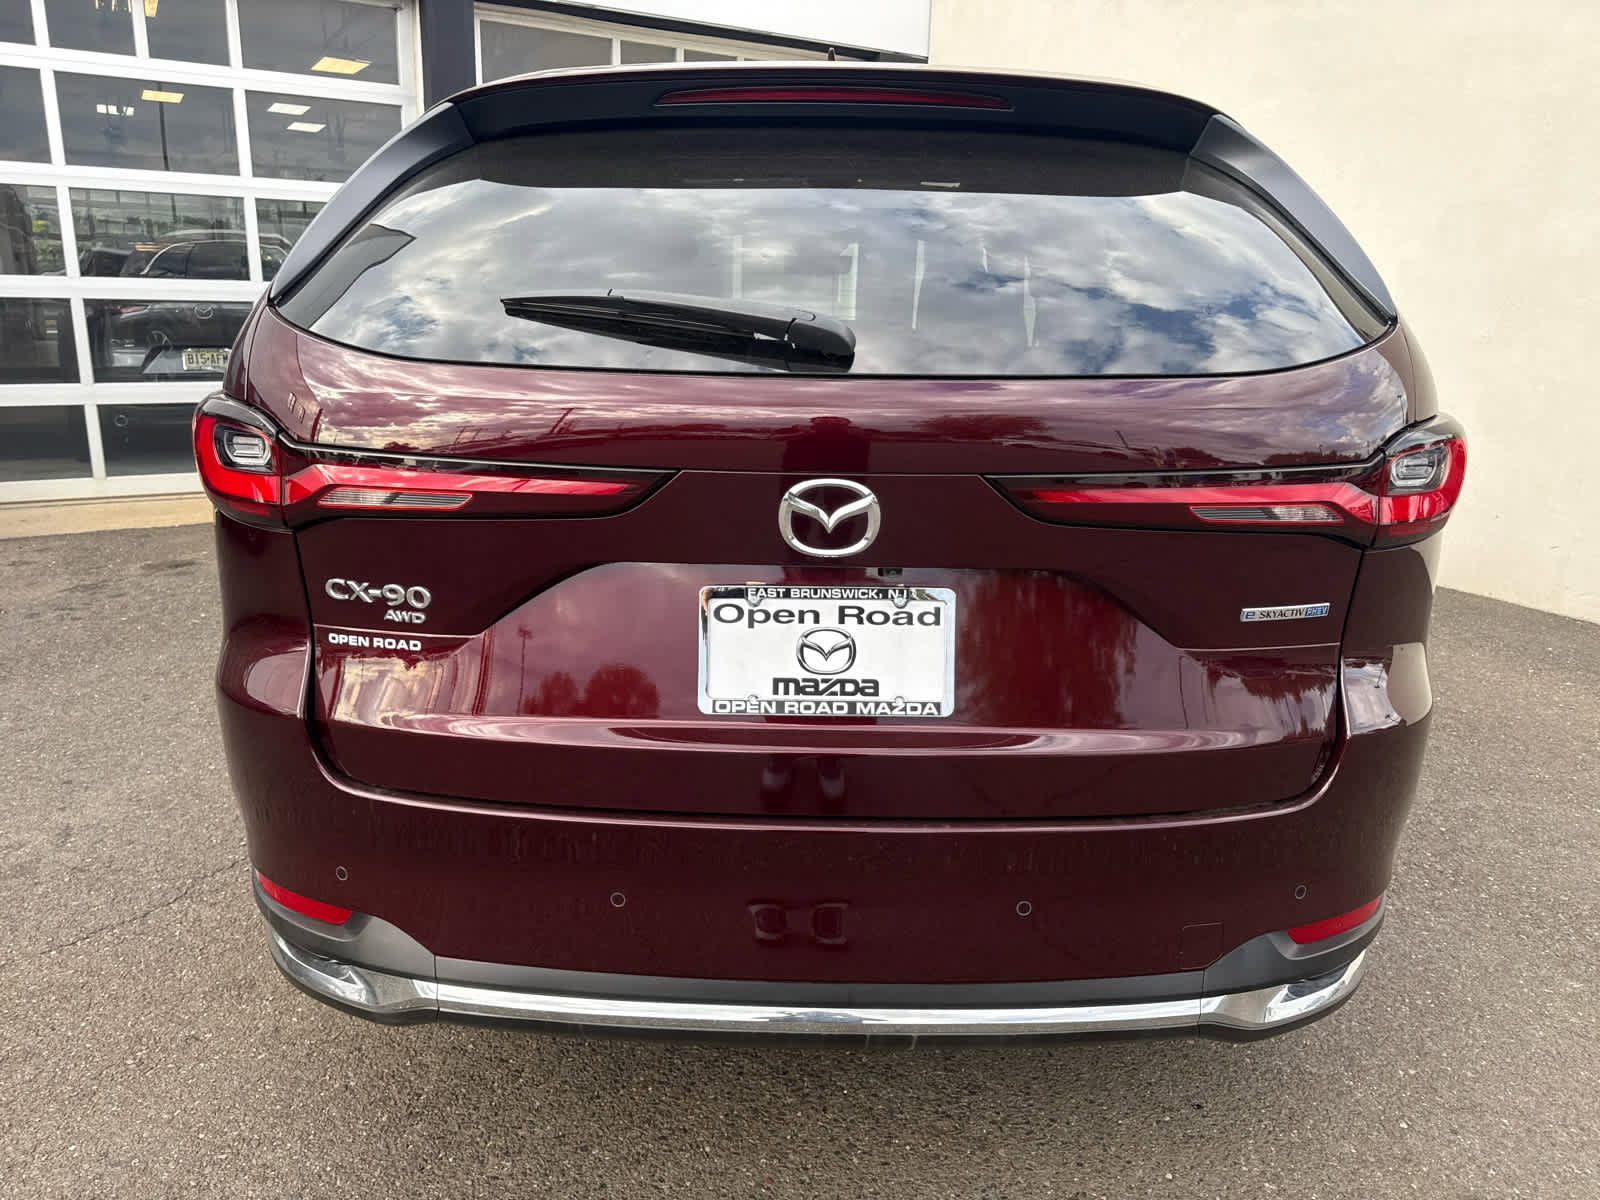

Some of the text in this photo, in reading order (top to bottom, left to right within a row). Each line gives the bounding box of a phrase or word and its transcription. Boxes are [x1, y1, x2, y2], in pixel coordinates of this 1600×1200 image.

[325, 578, 431, 608] CX-90
[747, 588, 785, 599] EAST
[790, 588, 882, 599] BRUNSWICK,
[383, 609, 426, 624] AWD
[713, 603, 941, 628] Open Road
[1259, 609, 1304, 619] SKYACTIV
[328, 632, 422, 651] OPEN ROAD
[714, 700, 939, 716] OPEN ROAD MAZDA
